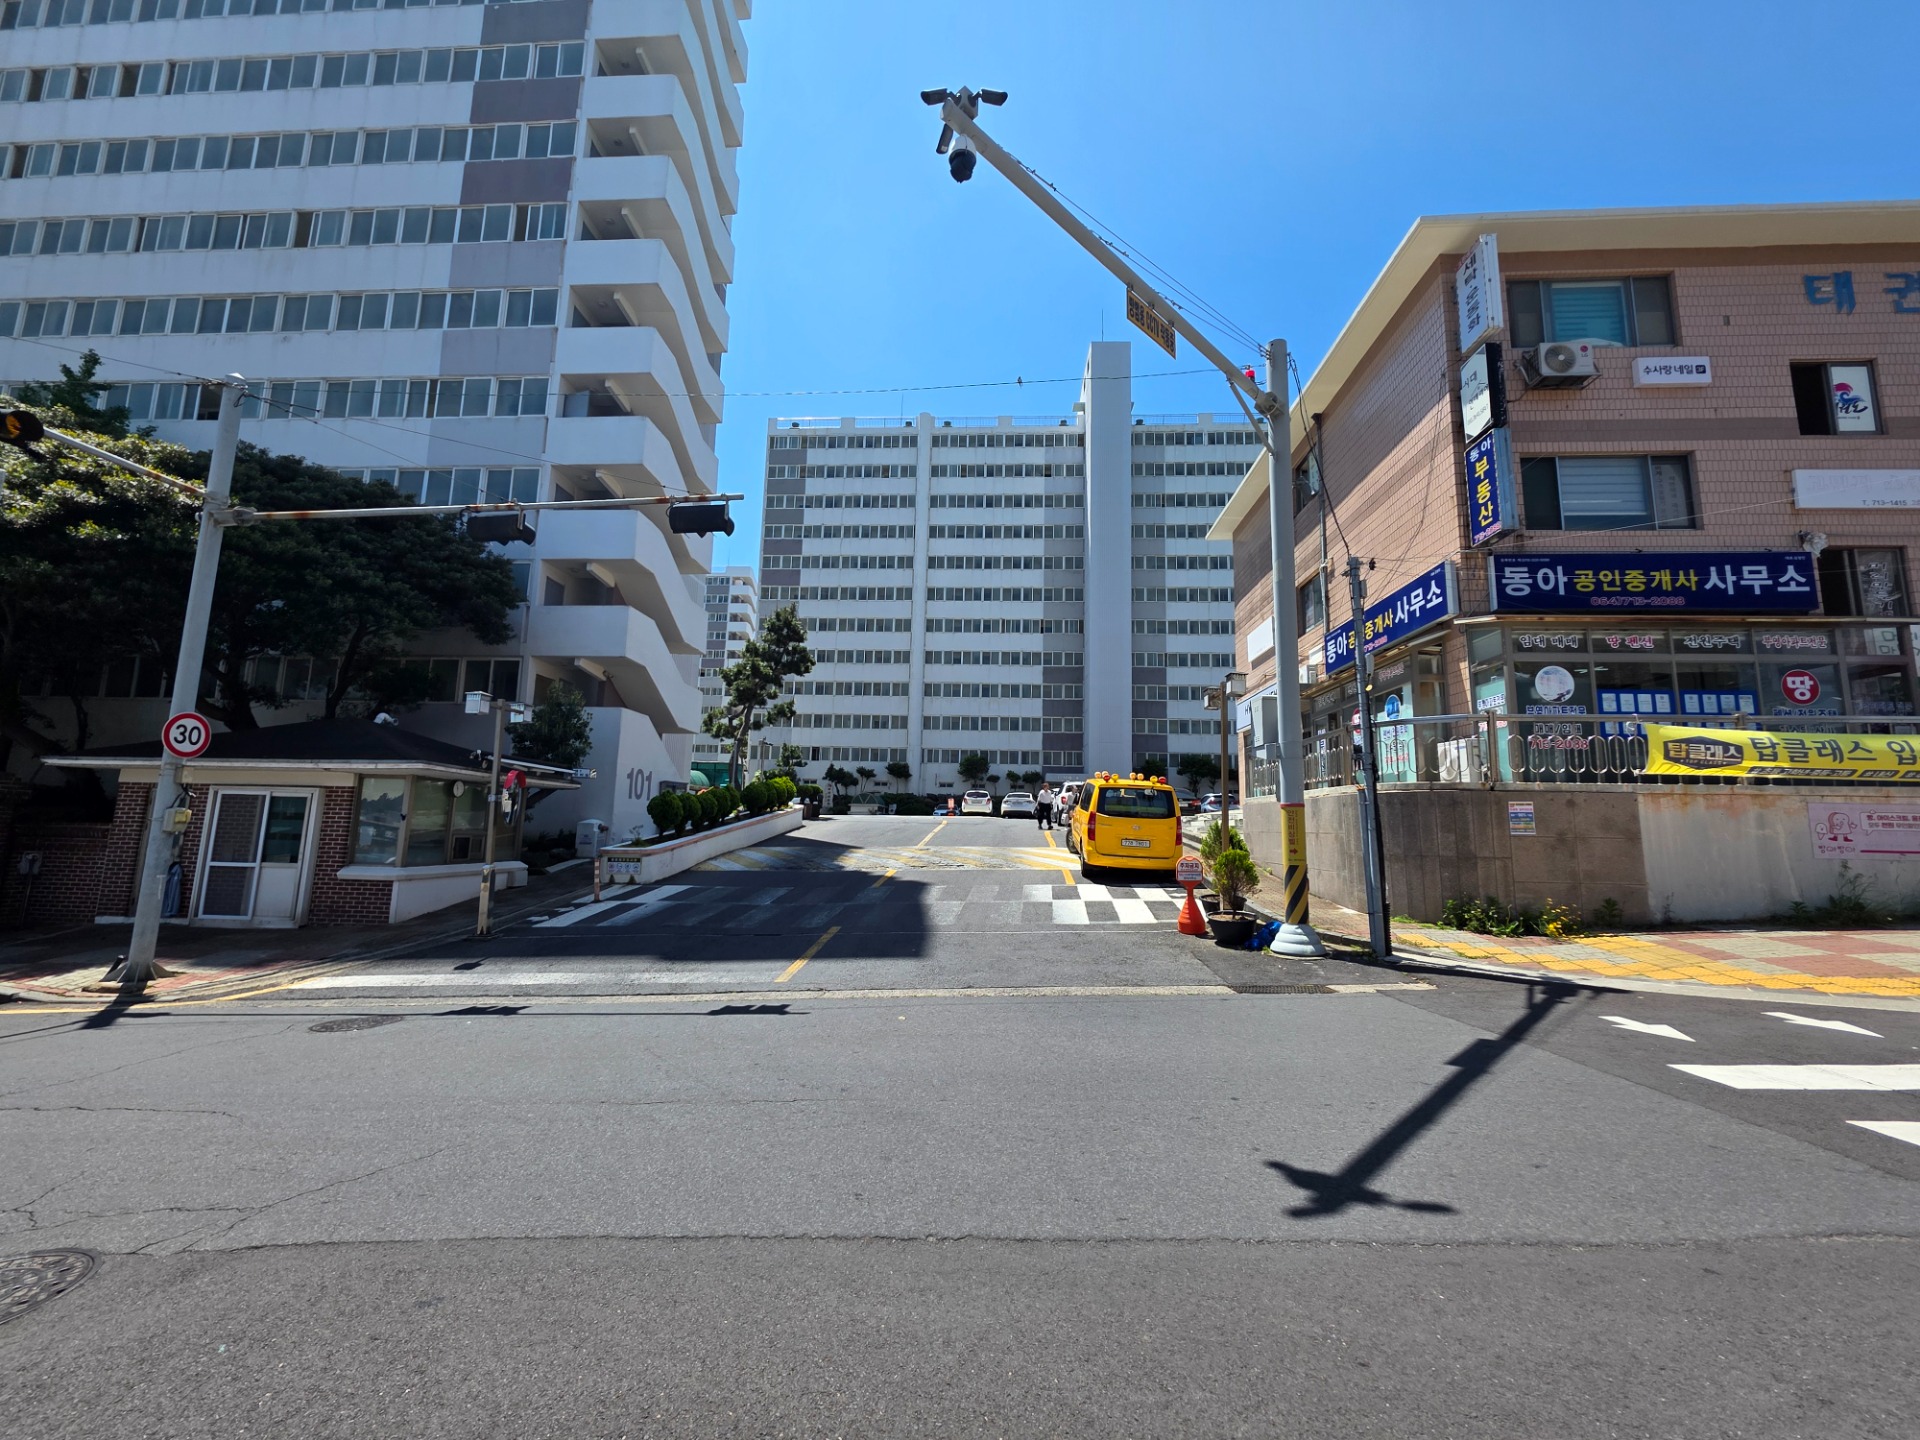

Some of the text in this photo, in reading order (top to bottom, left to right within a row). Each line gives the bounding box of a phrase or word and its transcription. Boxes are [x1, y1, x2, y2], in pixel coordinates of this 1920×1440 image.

[1146, 311, 1160, 338] CCTV
[1643, 365, 1672, 375] 수사랑
[1674, 364, 1694, 375] 네일
[1469, 437, 1492, 462] 동아
[1474, 456, 1494, 527] 부동산
[1501, 564, 1810, 596] 동아 공인중개사 사무소
[1326, 580, 1444, 664] 동아 공중개사 사무소
[1519, 635, 1578, 649] 임대 매매
[1605, 635, 1655, 649] 땅 펜션
[1684, 635, 1741, 649] 전원주택
[1786, 676, 1815, 701] 땅
[173, 724, 202, 746] 30
[1667, 742, 1742, 761] 탑클래스
[1748, 736, 1878, 764] 탑클래스
[626, 768, 653, 801] 101
